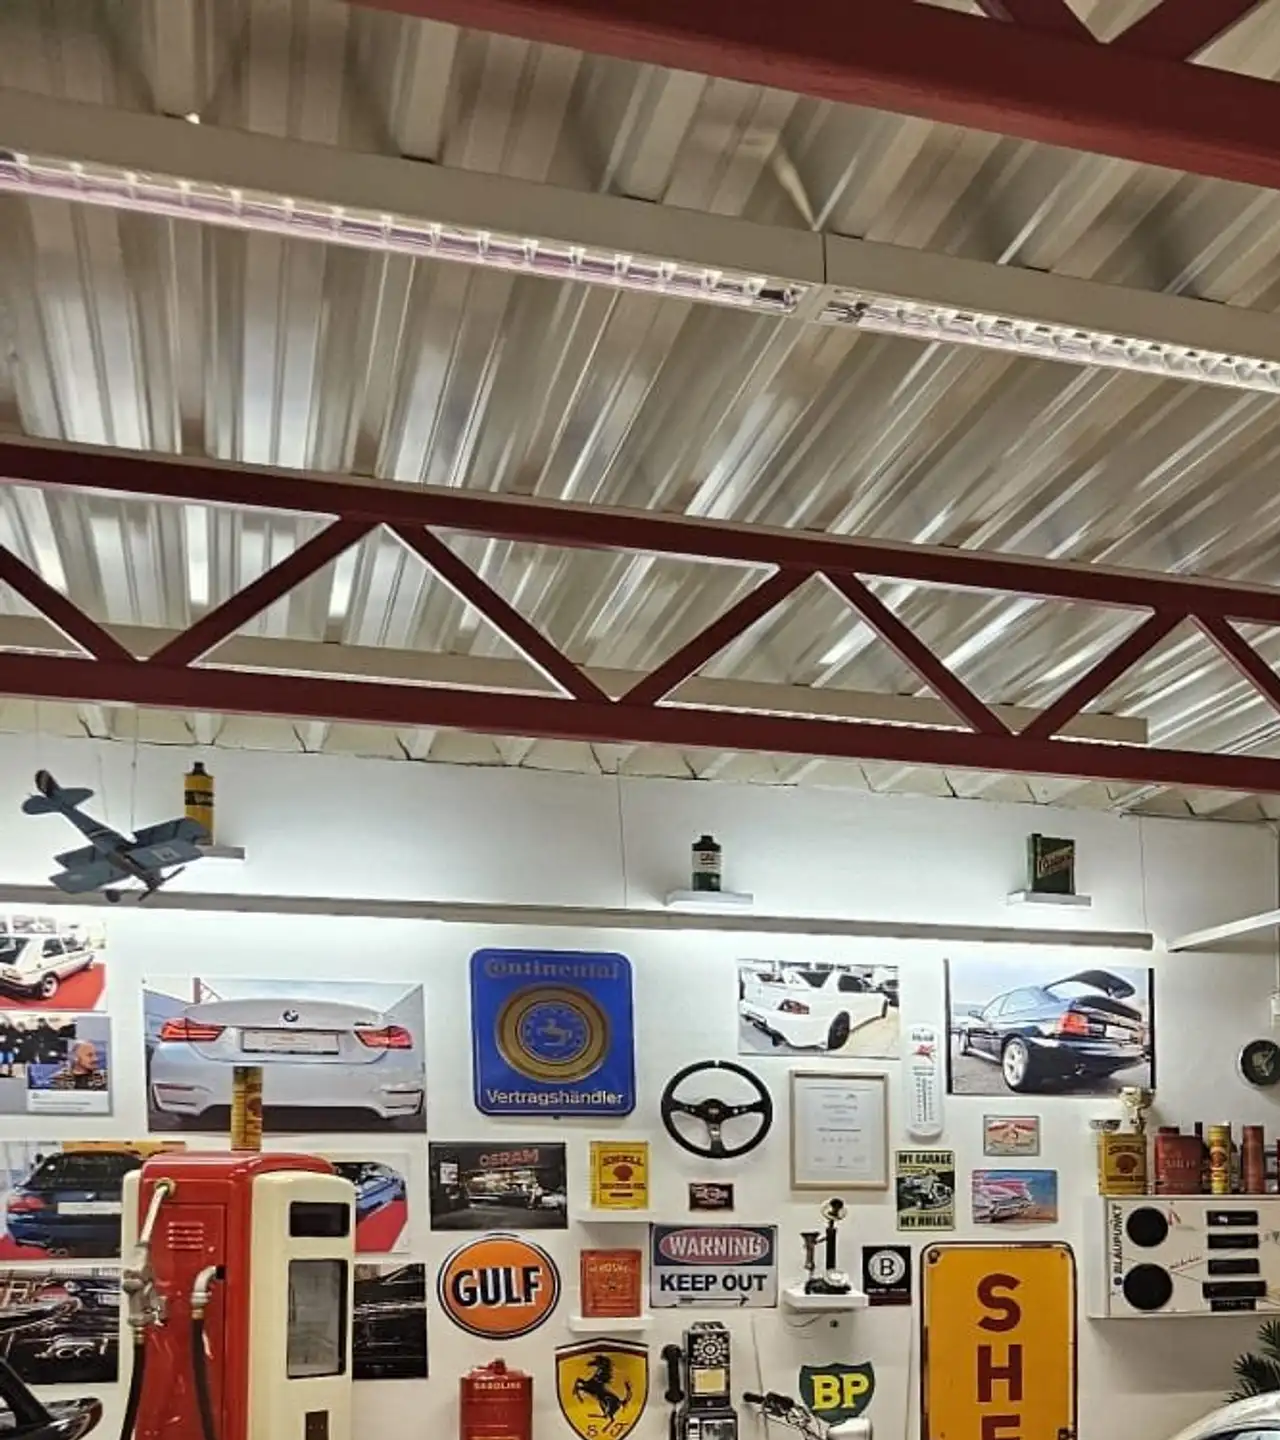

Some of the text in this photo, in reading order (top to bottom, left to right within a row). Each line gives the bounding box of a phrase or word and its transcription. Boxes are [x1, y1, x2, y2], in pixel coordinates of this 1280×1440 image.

[484, 959, 620, 979] Continental
[485, 1088, 624, 1106] Vertragshändler
[479, 1148, 539, 1167] OSRAM
[669, 1236, 762, 1257] WARNING
[1112, 1204, 1122, 1274] BLAUPUNKT
[452, 1266, 543, 1307] GULF
[660, 1274, 768, 1292] KEEP OUT
[811, 1373, 869, 1410] BP
